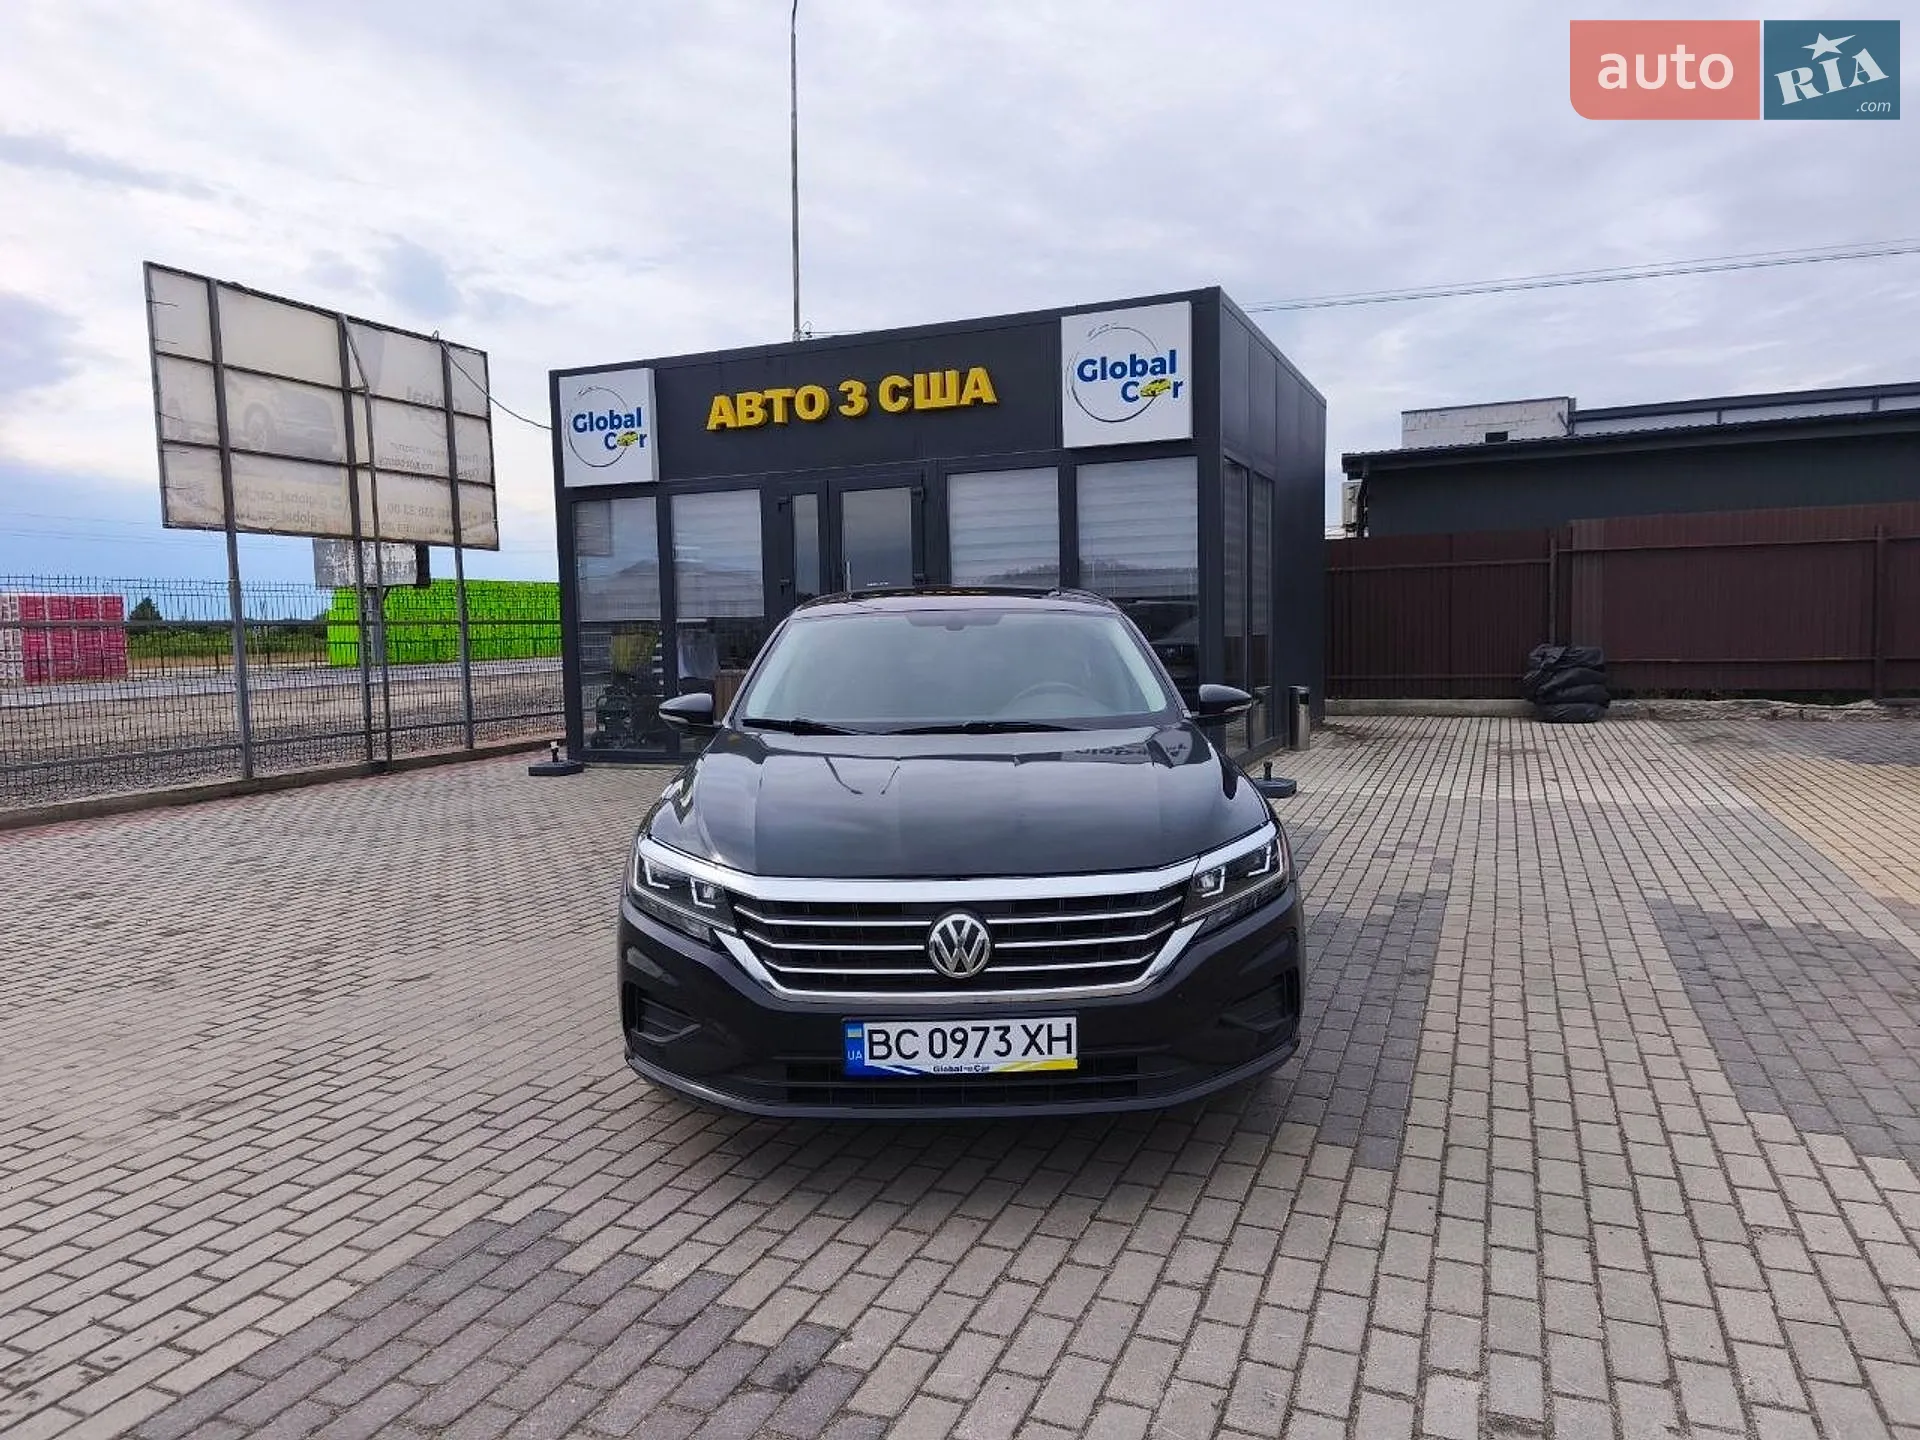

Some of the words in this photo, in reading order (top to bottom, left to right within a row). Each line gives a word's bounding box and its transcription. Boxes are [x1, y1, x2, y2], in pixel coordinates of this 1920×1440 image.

[1077, 349, 1177, 383] Global
[706, 383, 830, 431] АВТО
[838, 379, 870, 418] З
[878, 367, 998, 412] США
[1120, 379, 1184, 403] Cr
[572, 406, 643, 433] Global
[603, 431, 648, 451] Cr
[867, 1028, 920, 1061] BC
[928, 1026, 1013, 1060] 0973
[1020, 1022, 1074, 1057] XH
[847, 1050, 863, 1061] UA
